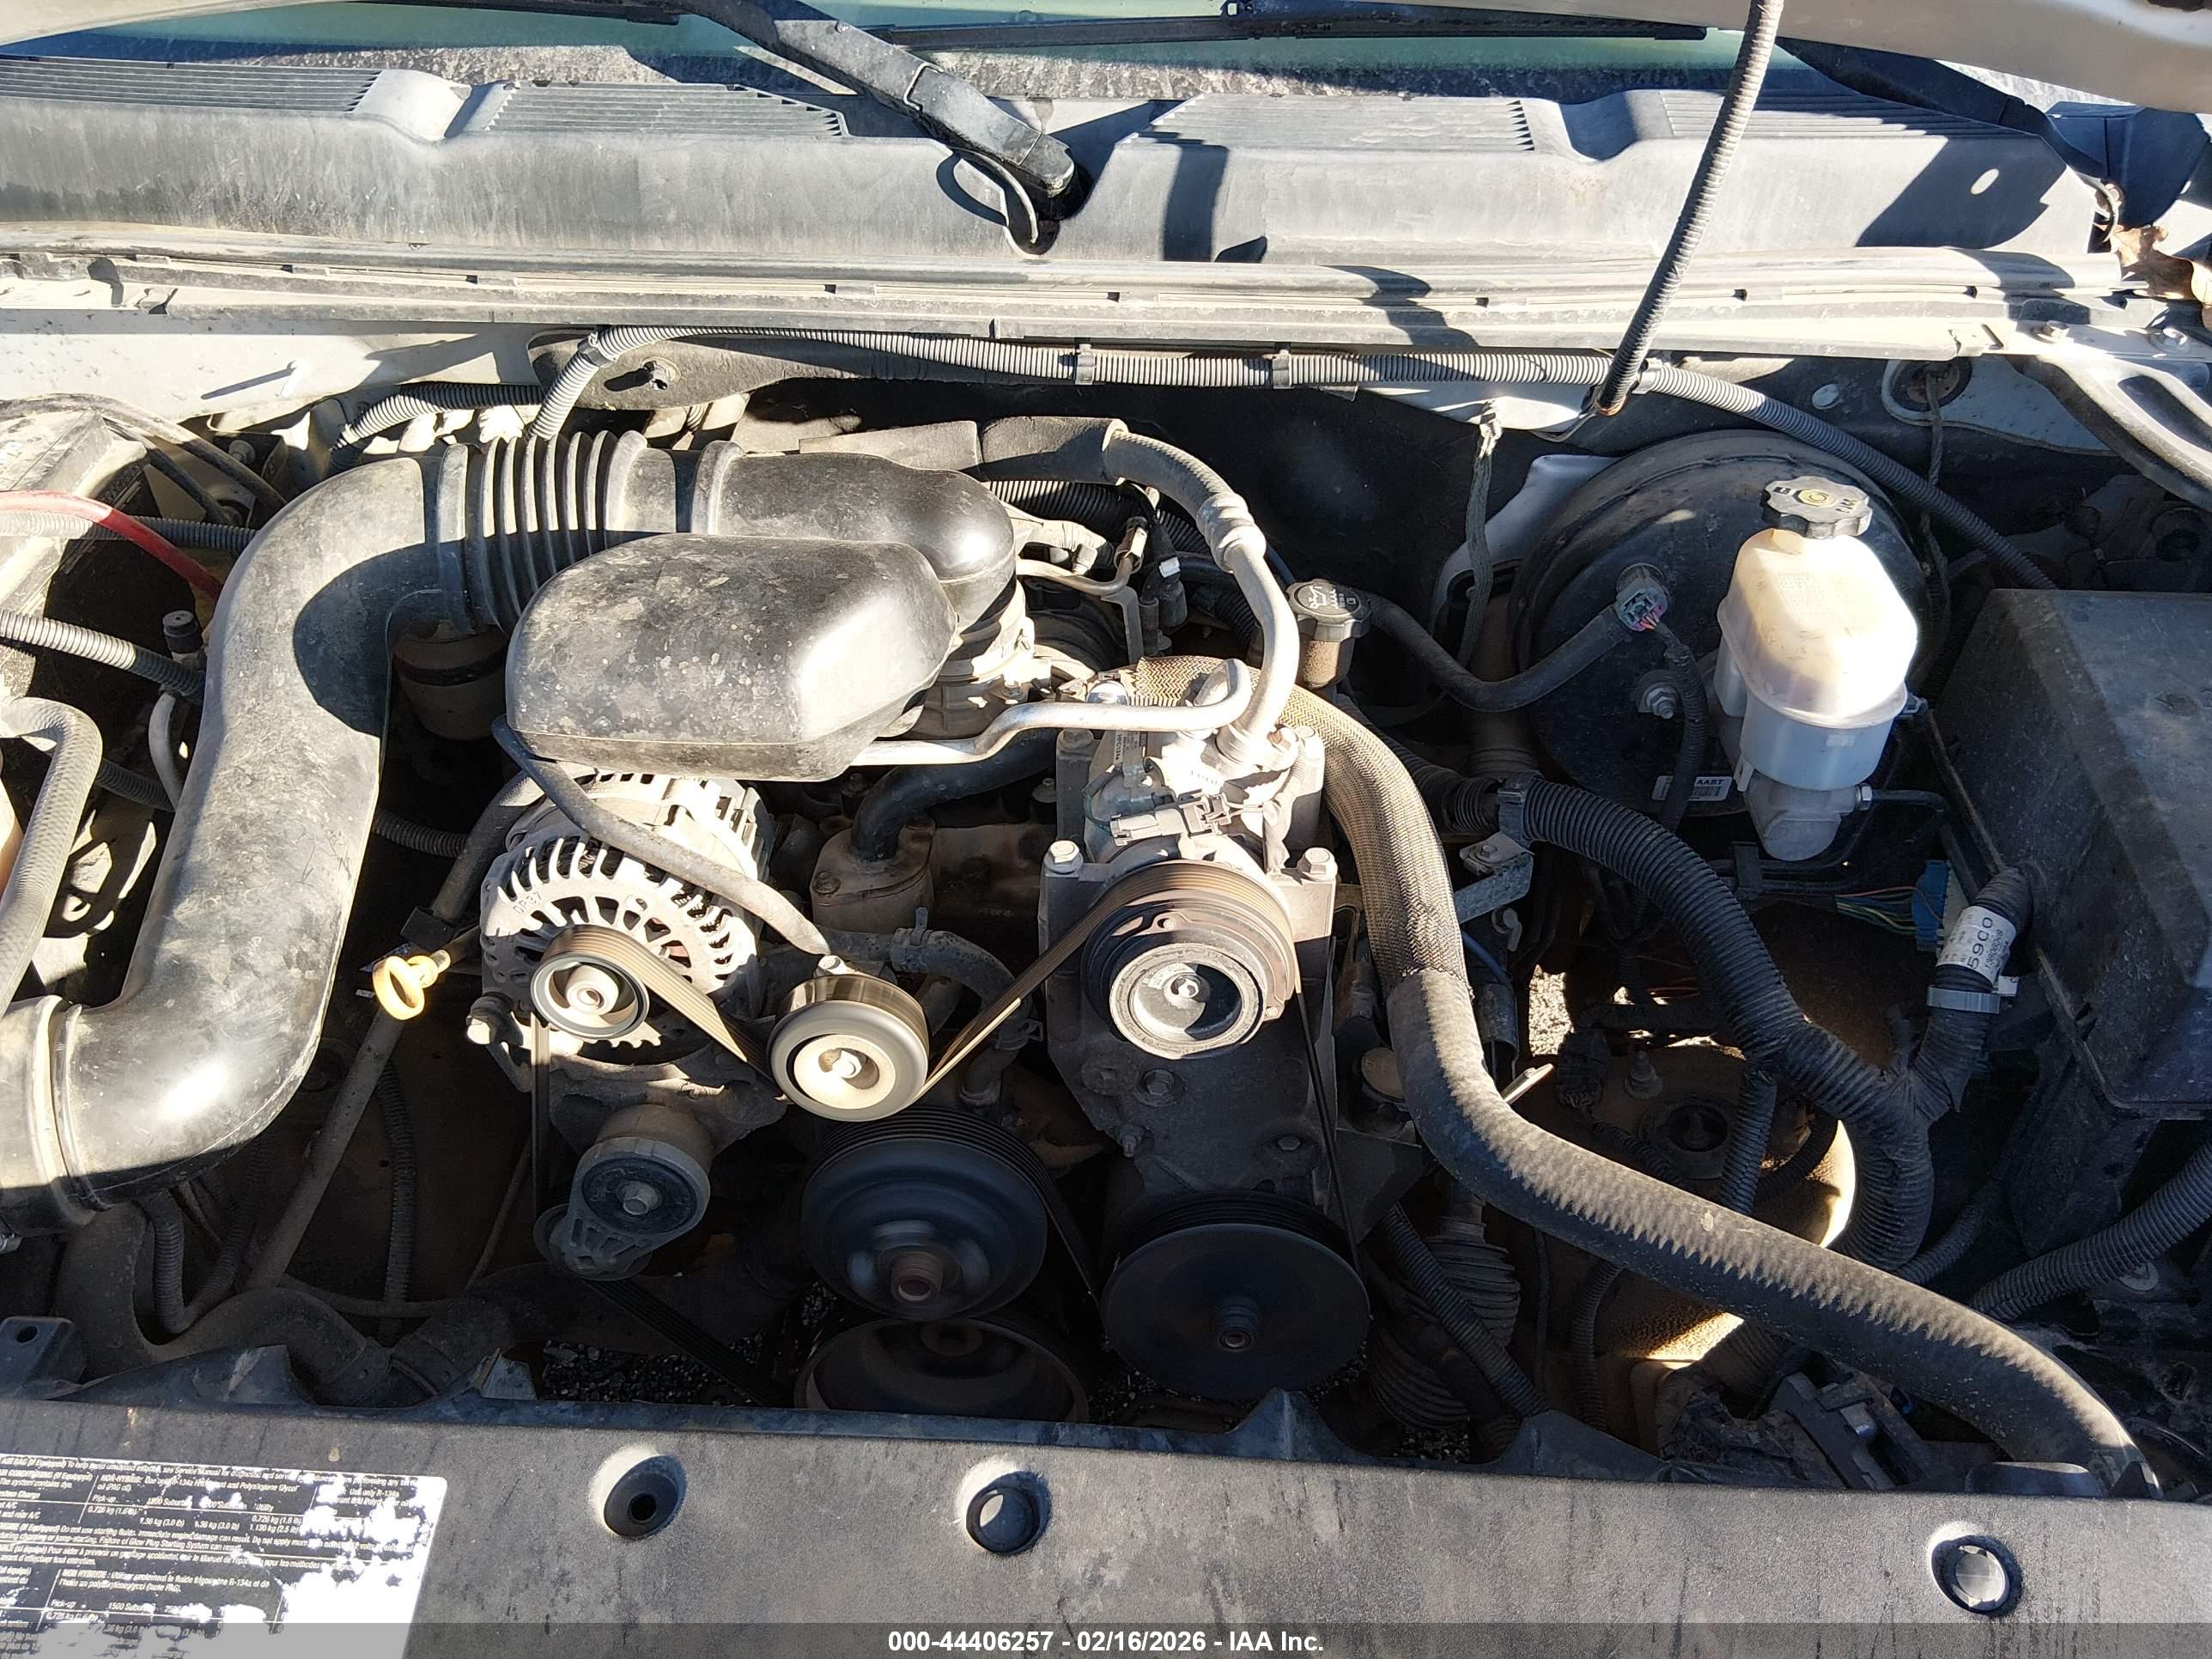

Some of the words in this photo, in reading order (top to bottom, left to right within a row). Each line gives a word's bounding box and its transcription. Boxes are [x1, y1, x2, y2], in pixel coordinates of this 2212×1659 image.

[1966, 916, 1993, 969] 5900
[36, 1458, 67, 1468] Equipped)
[76, 1462, 88, 1470] help
[230, 1470, 262, 1479] diagnostic
[18, 1491, 41, 1499] Charge
[93, 1495, 117, 1504] Pick-up
[129, 1537, 144, 1546] Glow
[145, 1539, 160, 1547] Plug
[185, 1541, 209, 1551] System
[48, 1546, 63, 1554] Pour
[228, 1578, 252, 1587] R-134a
[52, 1600, 76, 1608] Pick-up
[109, 1602, 125, 1611] 1500
